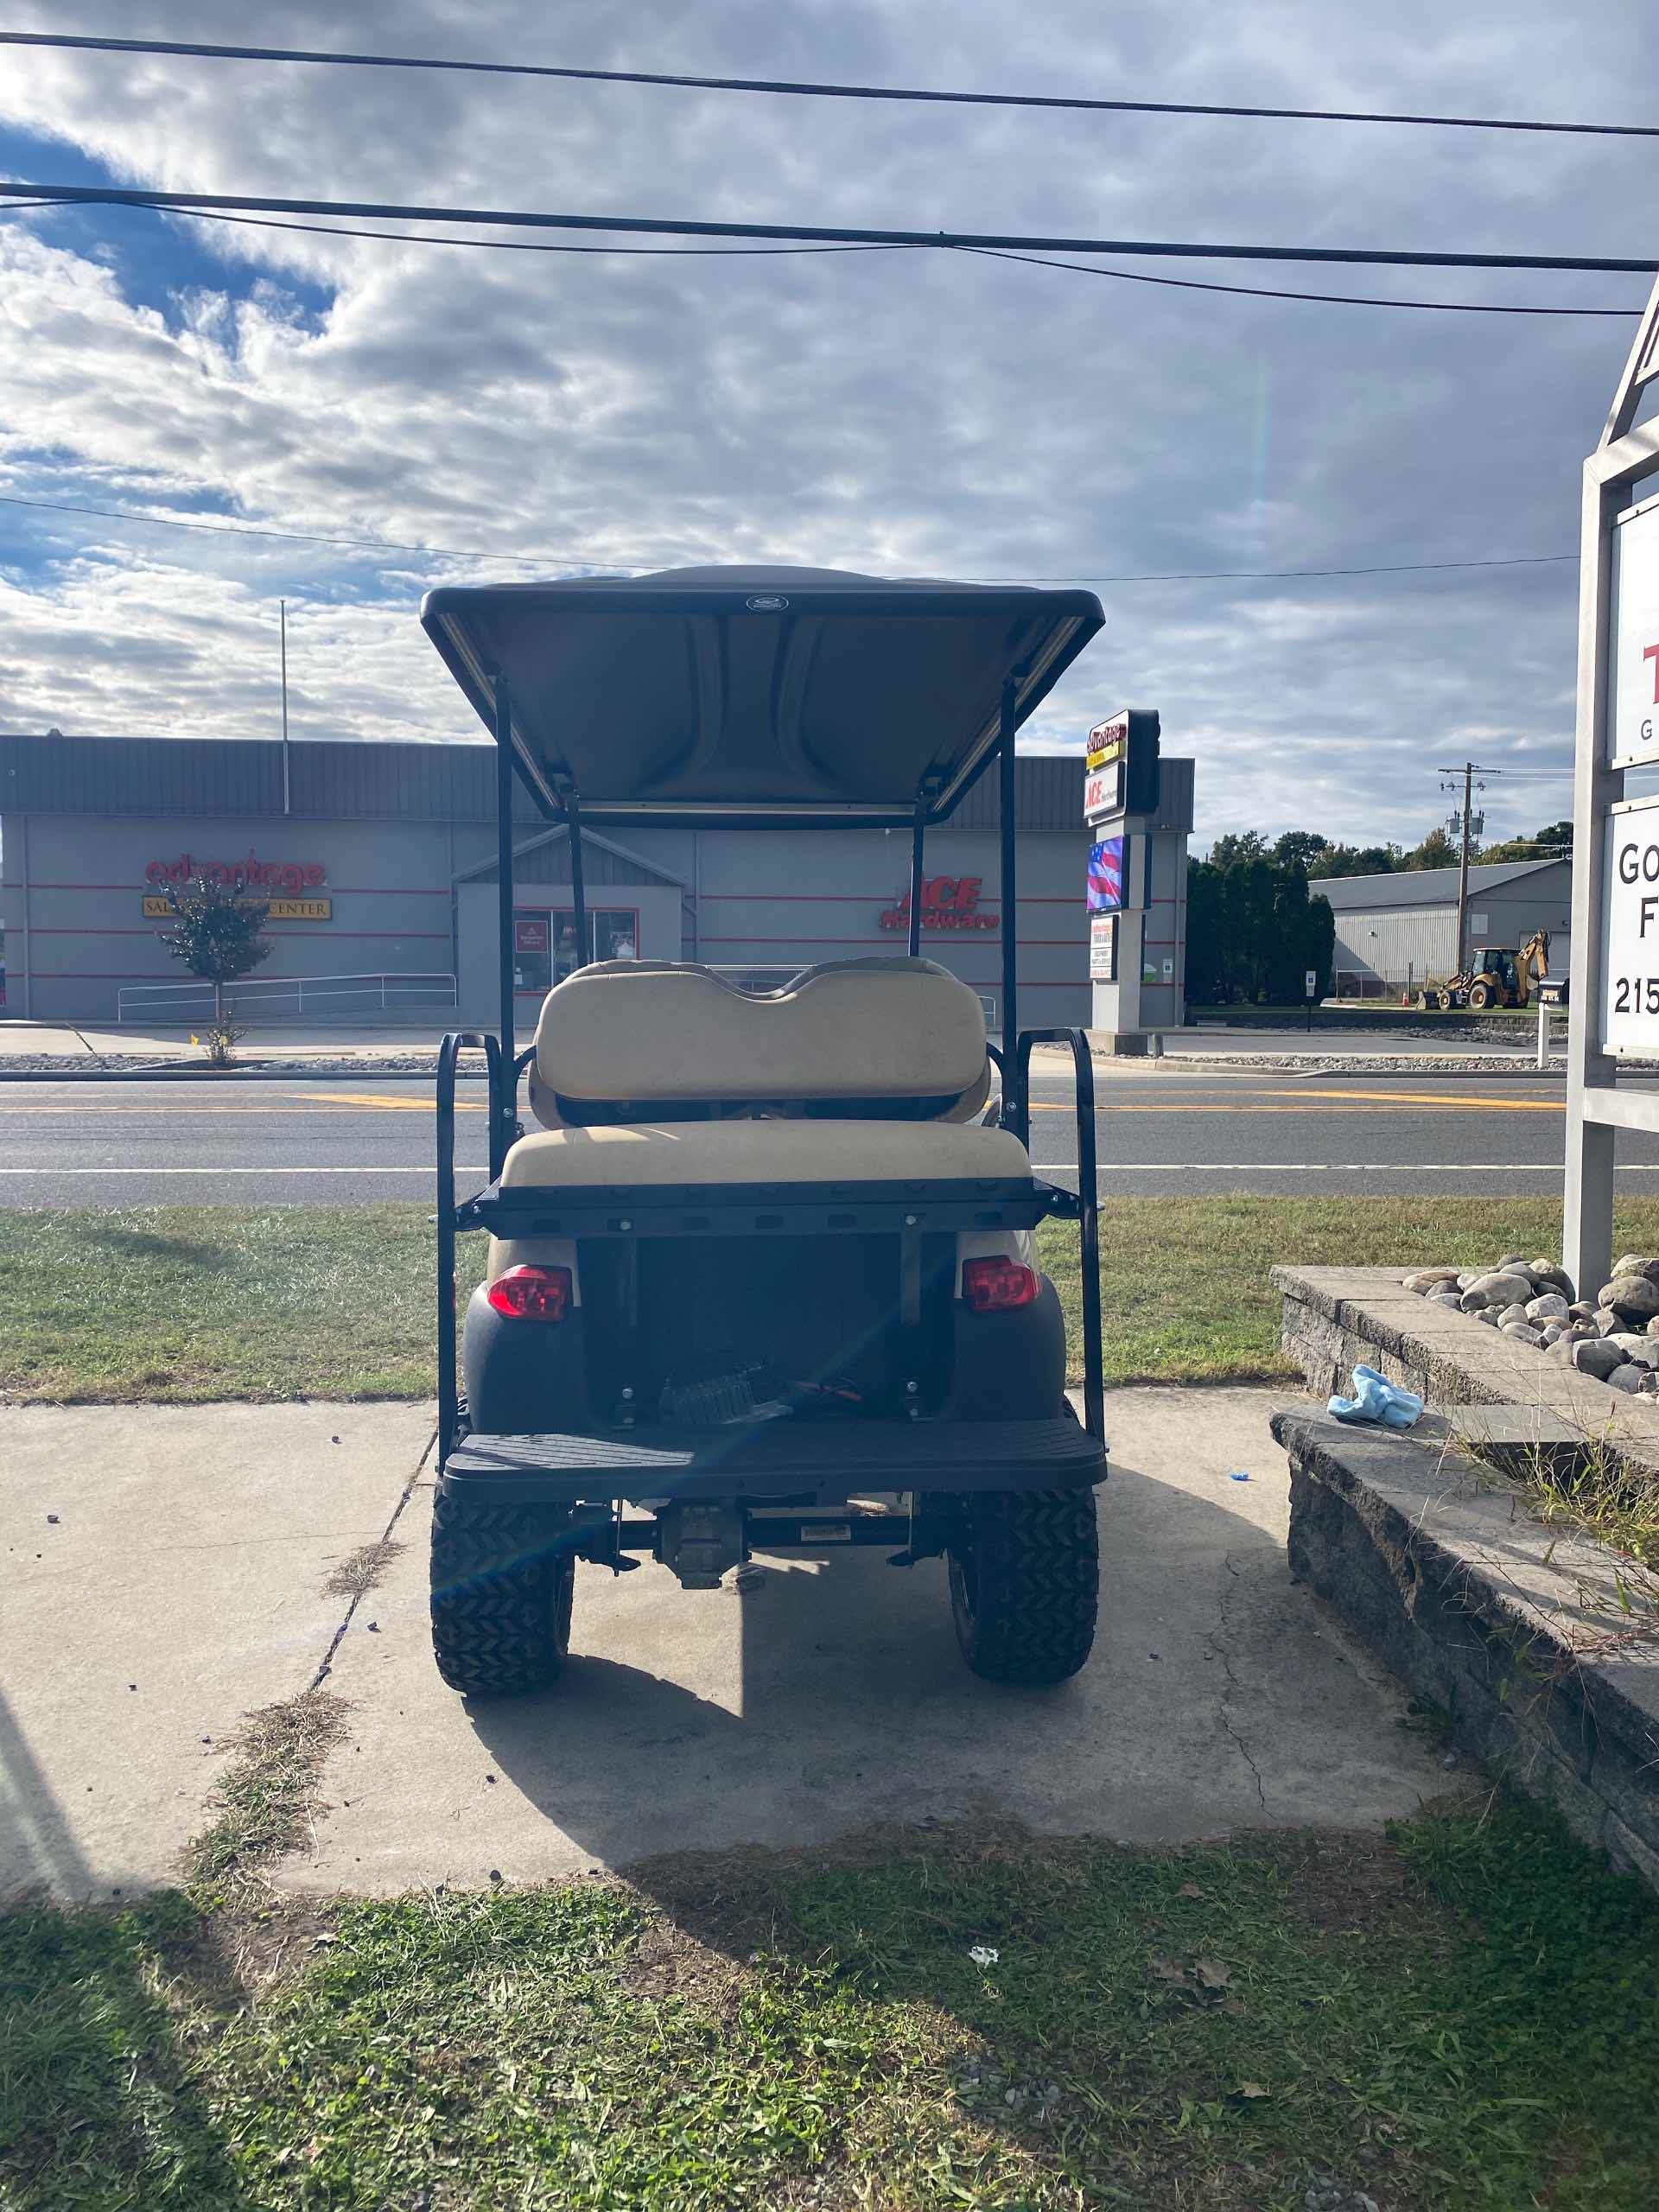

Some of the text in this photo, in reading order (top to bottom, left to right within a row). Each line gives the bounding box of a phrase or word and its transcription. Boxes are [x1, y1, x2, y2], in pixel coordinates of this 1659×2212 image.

[1641, 719, 1652, 740] G
[1086, 780, 1103, 809] ACE
[899, 874, 982, 912] ACE
[879, 910, 1000, 928] Hadware
